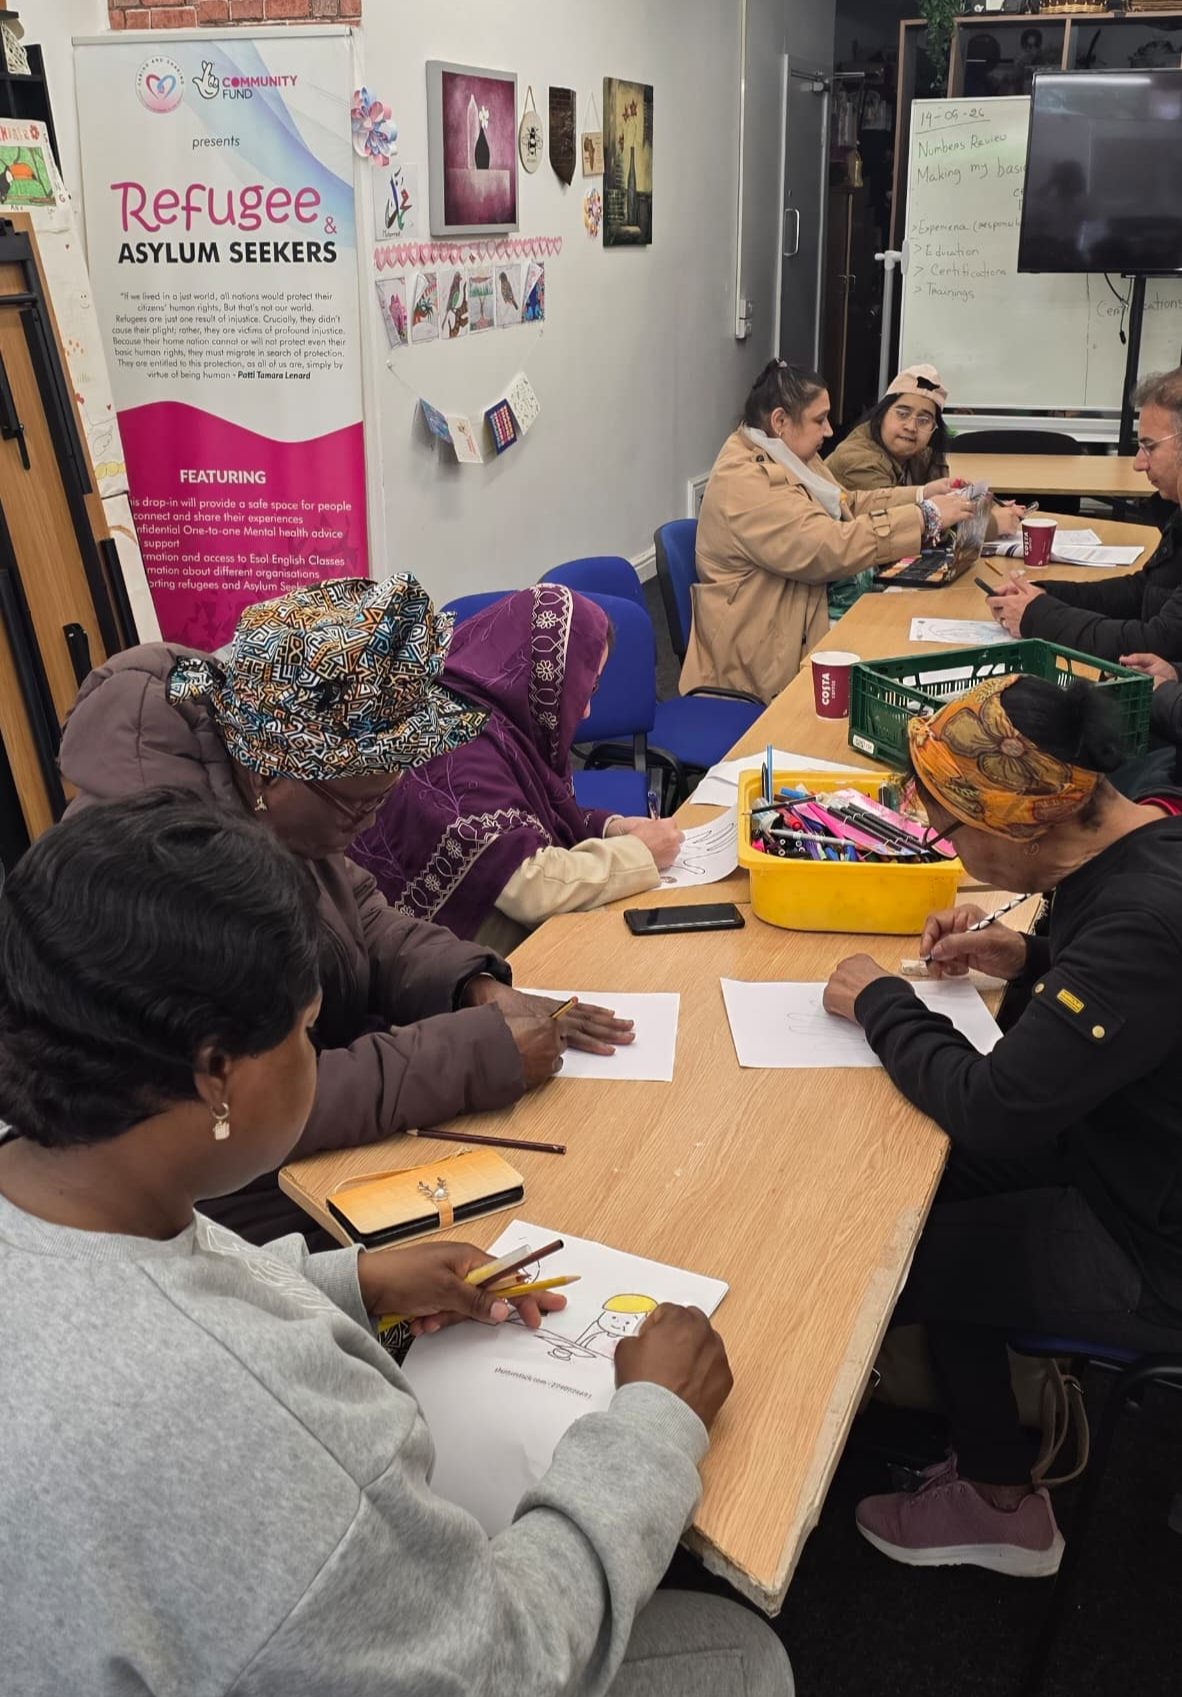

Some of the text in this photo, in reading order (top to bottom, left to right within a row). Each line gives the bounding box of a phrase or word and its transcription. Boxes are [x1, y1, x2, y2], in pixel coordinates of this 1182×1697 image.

[222, 75, 298, 88] COMMUNITY
[222, 89, 253, 100] FUND
[192, 136, 240, 150] presents
[917, 164, 961, 185] Making
[970, 162, 988, 179] my
[110, 182, 338, 234] Refugee &
[118, 241, 337, 264] ASYLUM SEEKERS
[179, 292, 192, 302] just
[194, 292, 218, 301] world,
[287, 292, 312, 302] protect
[116, 314, 147, 324] Refugees
[165, 315, 178, 324] just
[263, 315, 298, 324] Crucially,
[300, 315, 315, 324] they
[204, 326, 220, 336] they
[275, 326, 310, 335] profound
[113, 337, 141, 345] Because
[280, 338, 305, 347] protect
[188, 348, 203, 358] they
[227, 349, 256, 358] migrate
[118, 360, 133, 368] They
[307, 362, 331, 370] simply
[334, 361, 343, 370] by
[181, 371, 200, 380] being
[180, 470, 266, 484] FEATURING
[143, 497, 178, 508] drop-in
[181, 497, 196, 507] will
[199, 499, 236, 509] provide
[248, 499, 268, 509] safe
[271, 502, 298, 511] space
[301, 500, 314, 510] for
[318, 501, 352, 512] people
[133, 512, 303, 524] connect and share their experiences
[136, 524, 343, 538] nfidential One-to-one Mental health advice
[144, 540, 180, 549] support
[182, 552, 200, 562] and
[204, 554, 234, 563] access
[238, 554, 247, 563] to
[250, 553, 269, 563] Esol
[272, 554, 305, 566] English
[309, 556, 344, 566] Classes
[147, 565, 320, 579] mation about different organisations
[150, 579, 306, 592] orting refugees and Asylum Seek
[822, 672, 830, 706] COSTA
